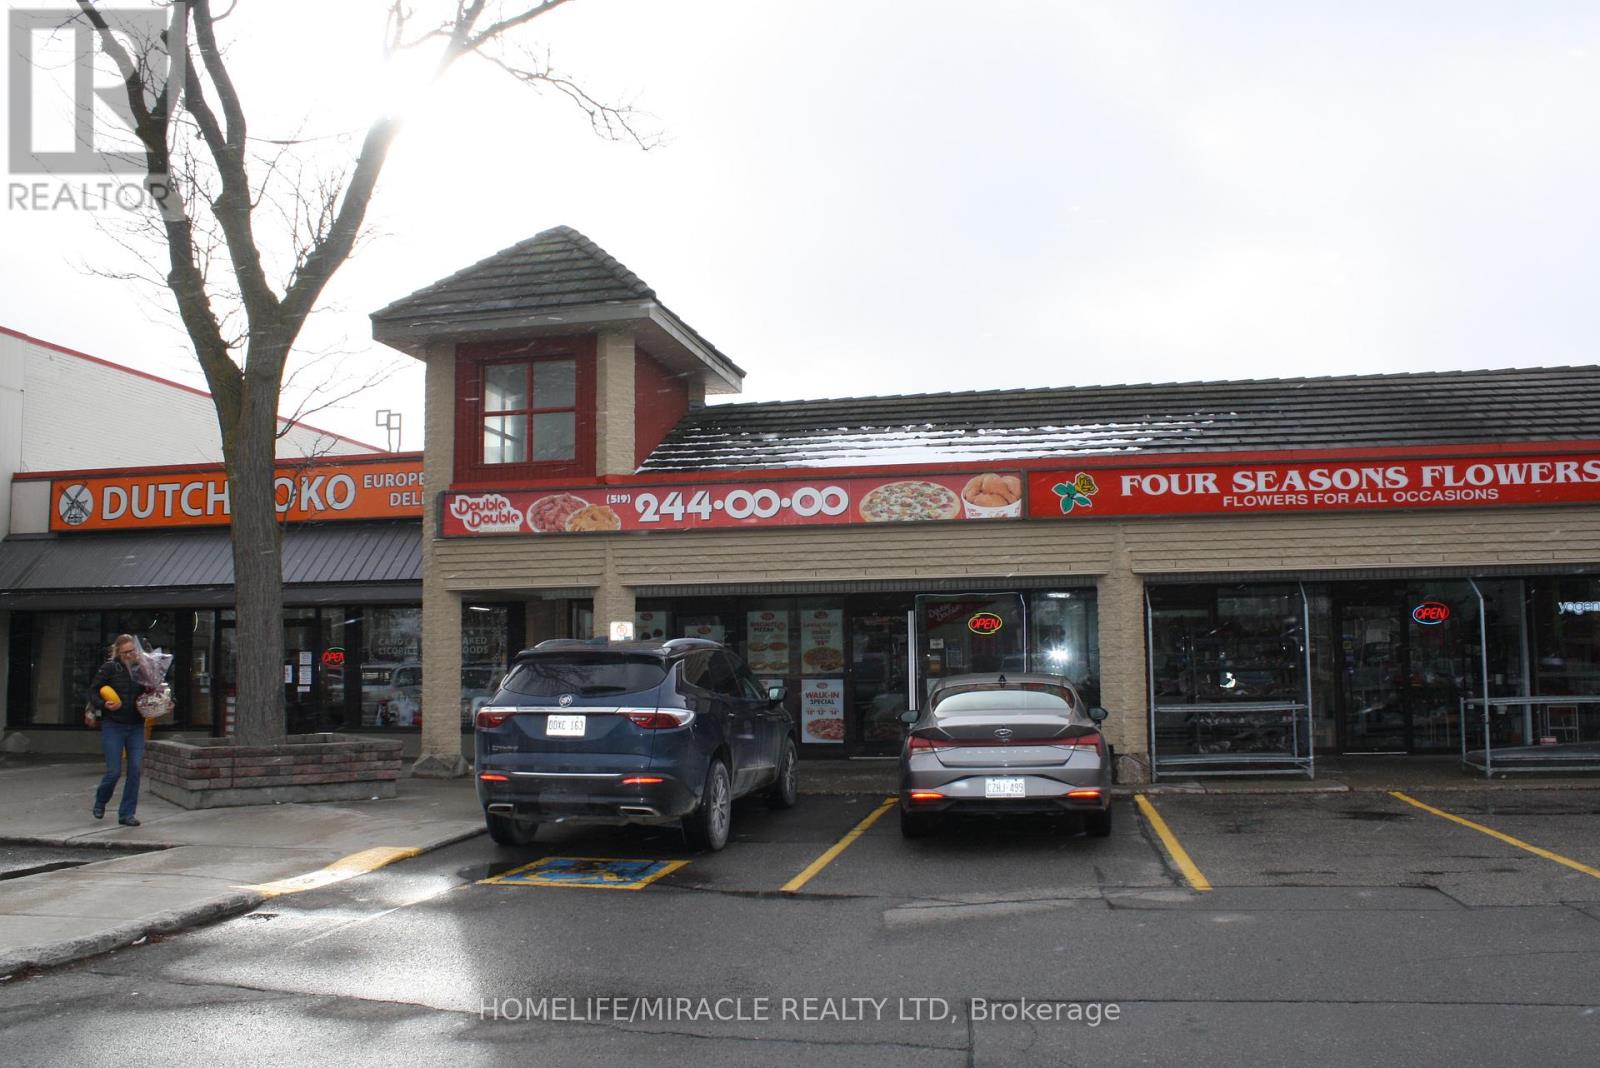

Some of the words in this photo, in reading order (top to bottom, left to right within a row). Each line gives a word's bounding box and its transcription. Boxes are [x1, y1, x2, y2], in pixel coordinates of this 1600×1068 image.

[1120, 473, 1220, 496] FOUR
[1232, 467, 1408, 493] SEASONS
[1421, 460, 1600, 487] FLOWERS
[102, 480, 231, 520] DUTCH
[274, 474, 356, 512] OKO
[606, 494, 631, 505] (519)
[1223, 494, 1308, 507] FLOWERS
[1314, 492, 1349, 504] FOR
[1355, 491, 1388, 503] ALL
[1393, 488, 1499, 502] OCCASIONS
[455, 498, 507, 515] Double
[468, 511, 520, 528] Double
[1416, 607, 1446, 620] OPEN
[971, 618, 999, 629] OPEN
[463, 637, 488, 645] AKED
[463, 646, 489, 655] OODS
[805, 691, 840, 699] WALK-IN
